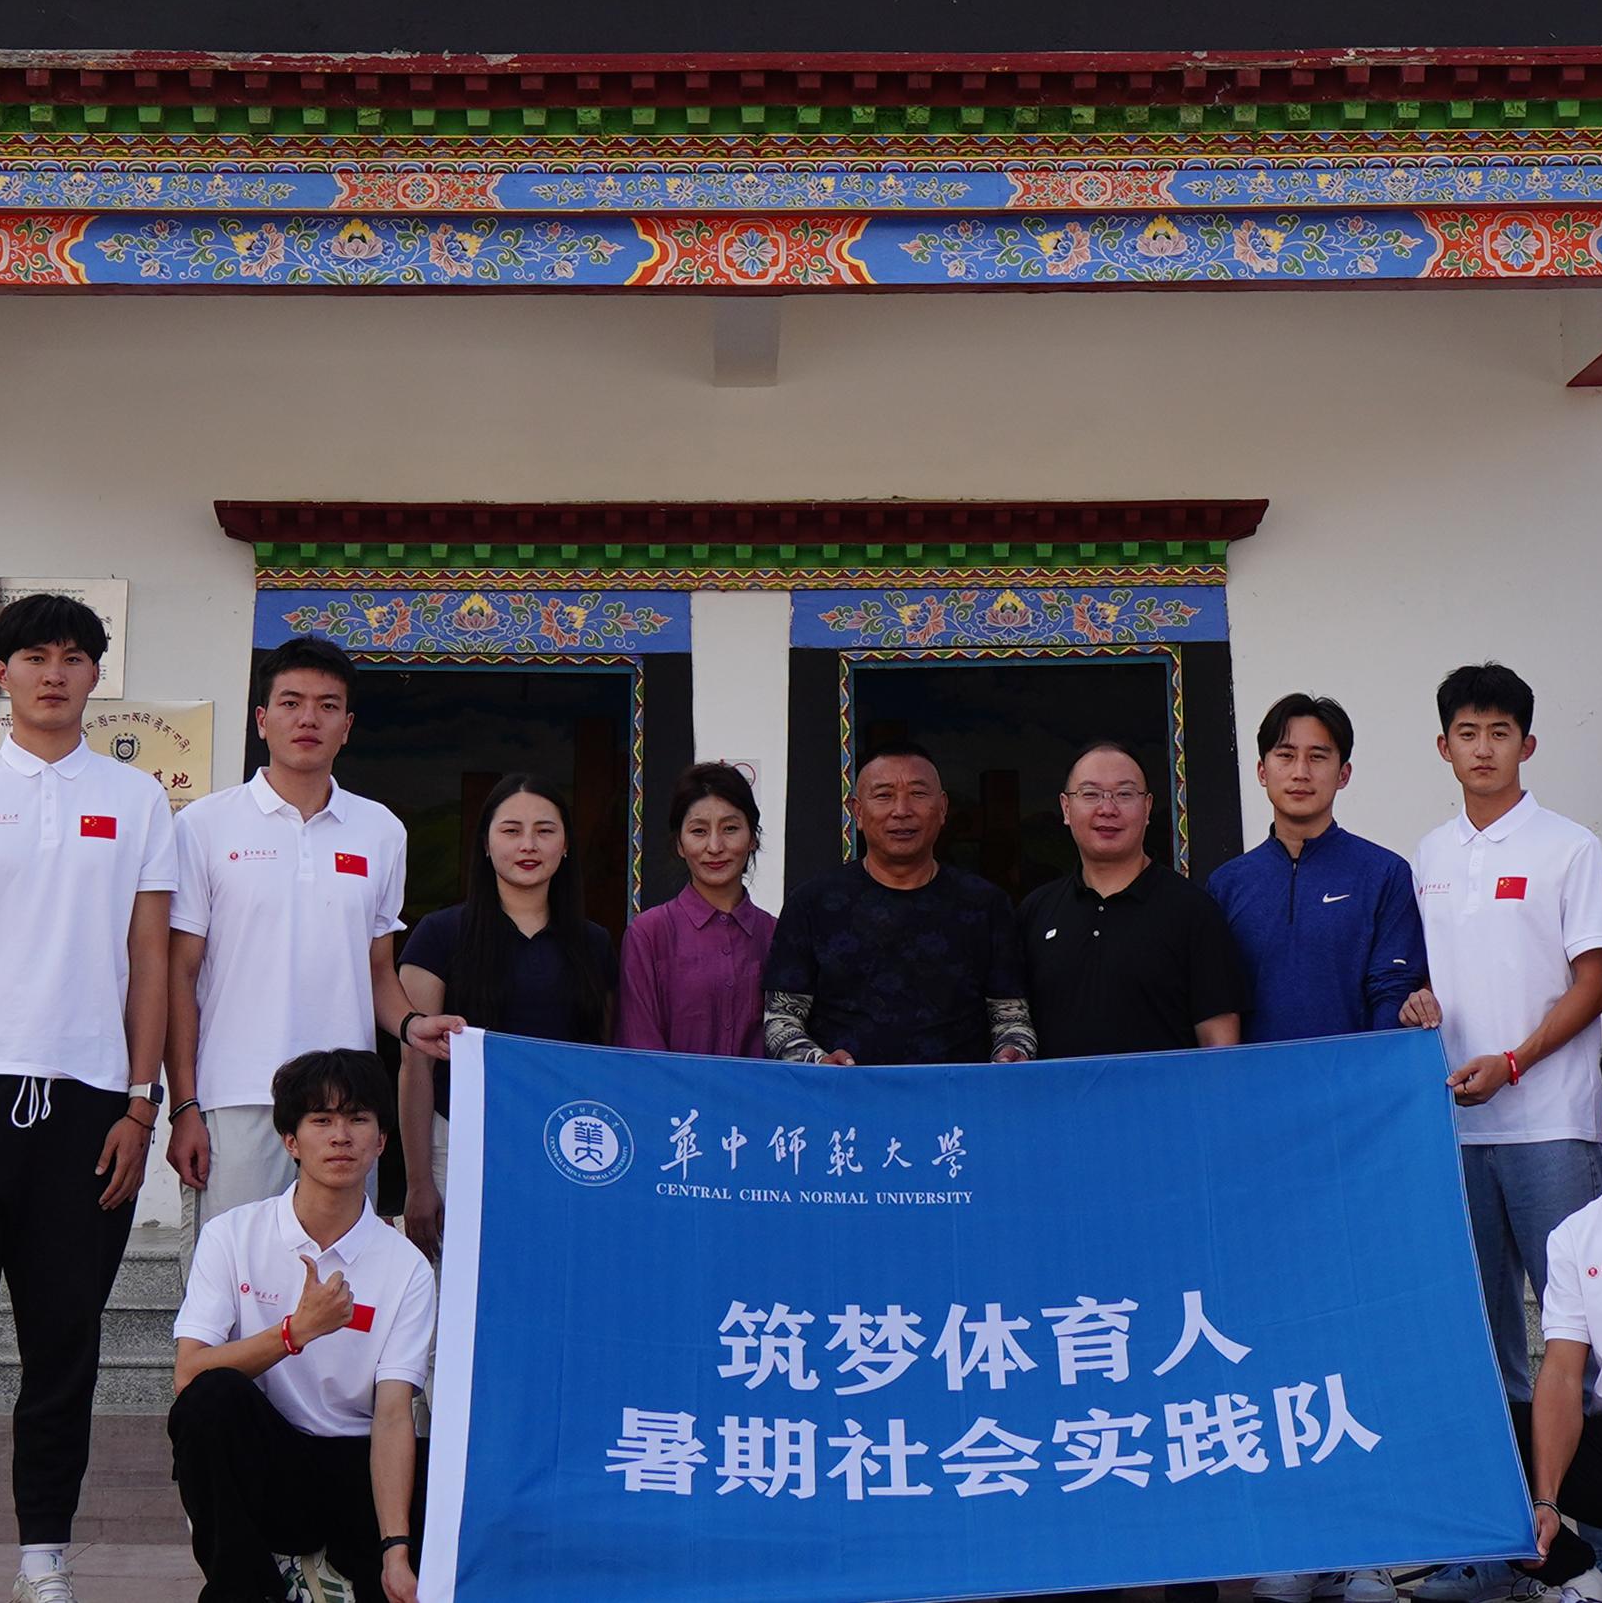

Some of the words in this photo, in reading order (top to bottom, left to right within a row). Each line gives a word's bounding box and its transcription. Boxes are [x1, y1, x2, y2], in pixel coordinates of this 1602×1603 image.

[656, 1183, 732, 1200] CENTRAL
[739, 1189, 792, 1203] CHINA
[799, 1191, 868, 1205] NORMAL
[876, 1191, 973, 1205] UNIVERSITY
[716, 1289, 1252, 1394] 筑梦体育人
[603, 1372, 1382, 1500] 暑期社会实践队
